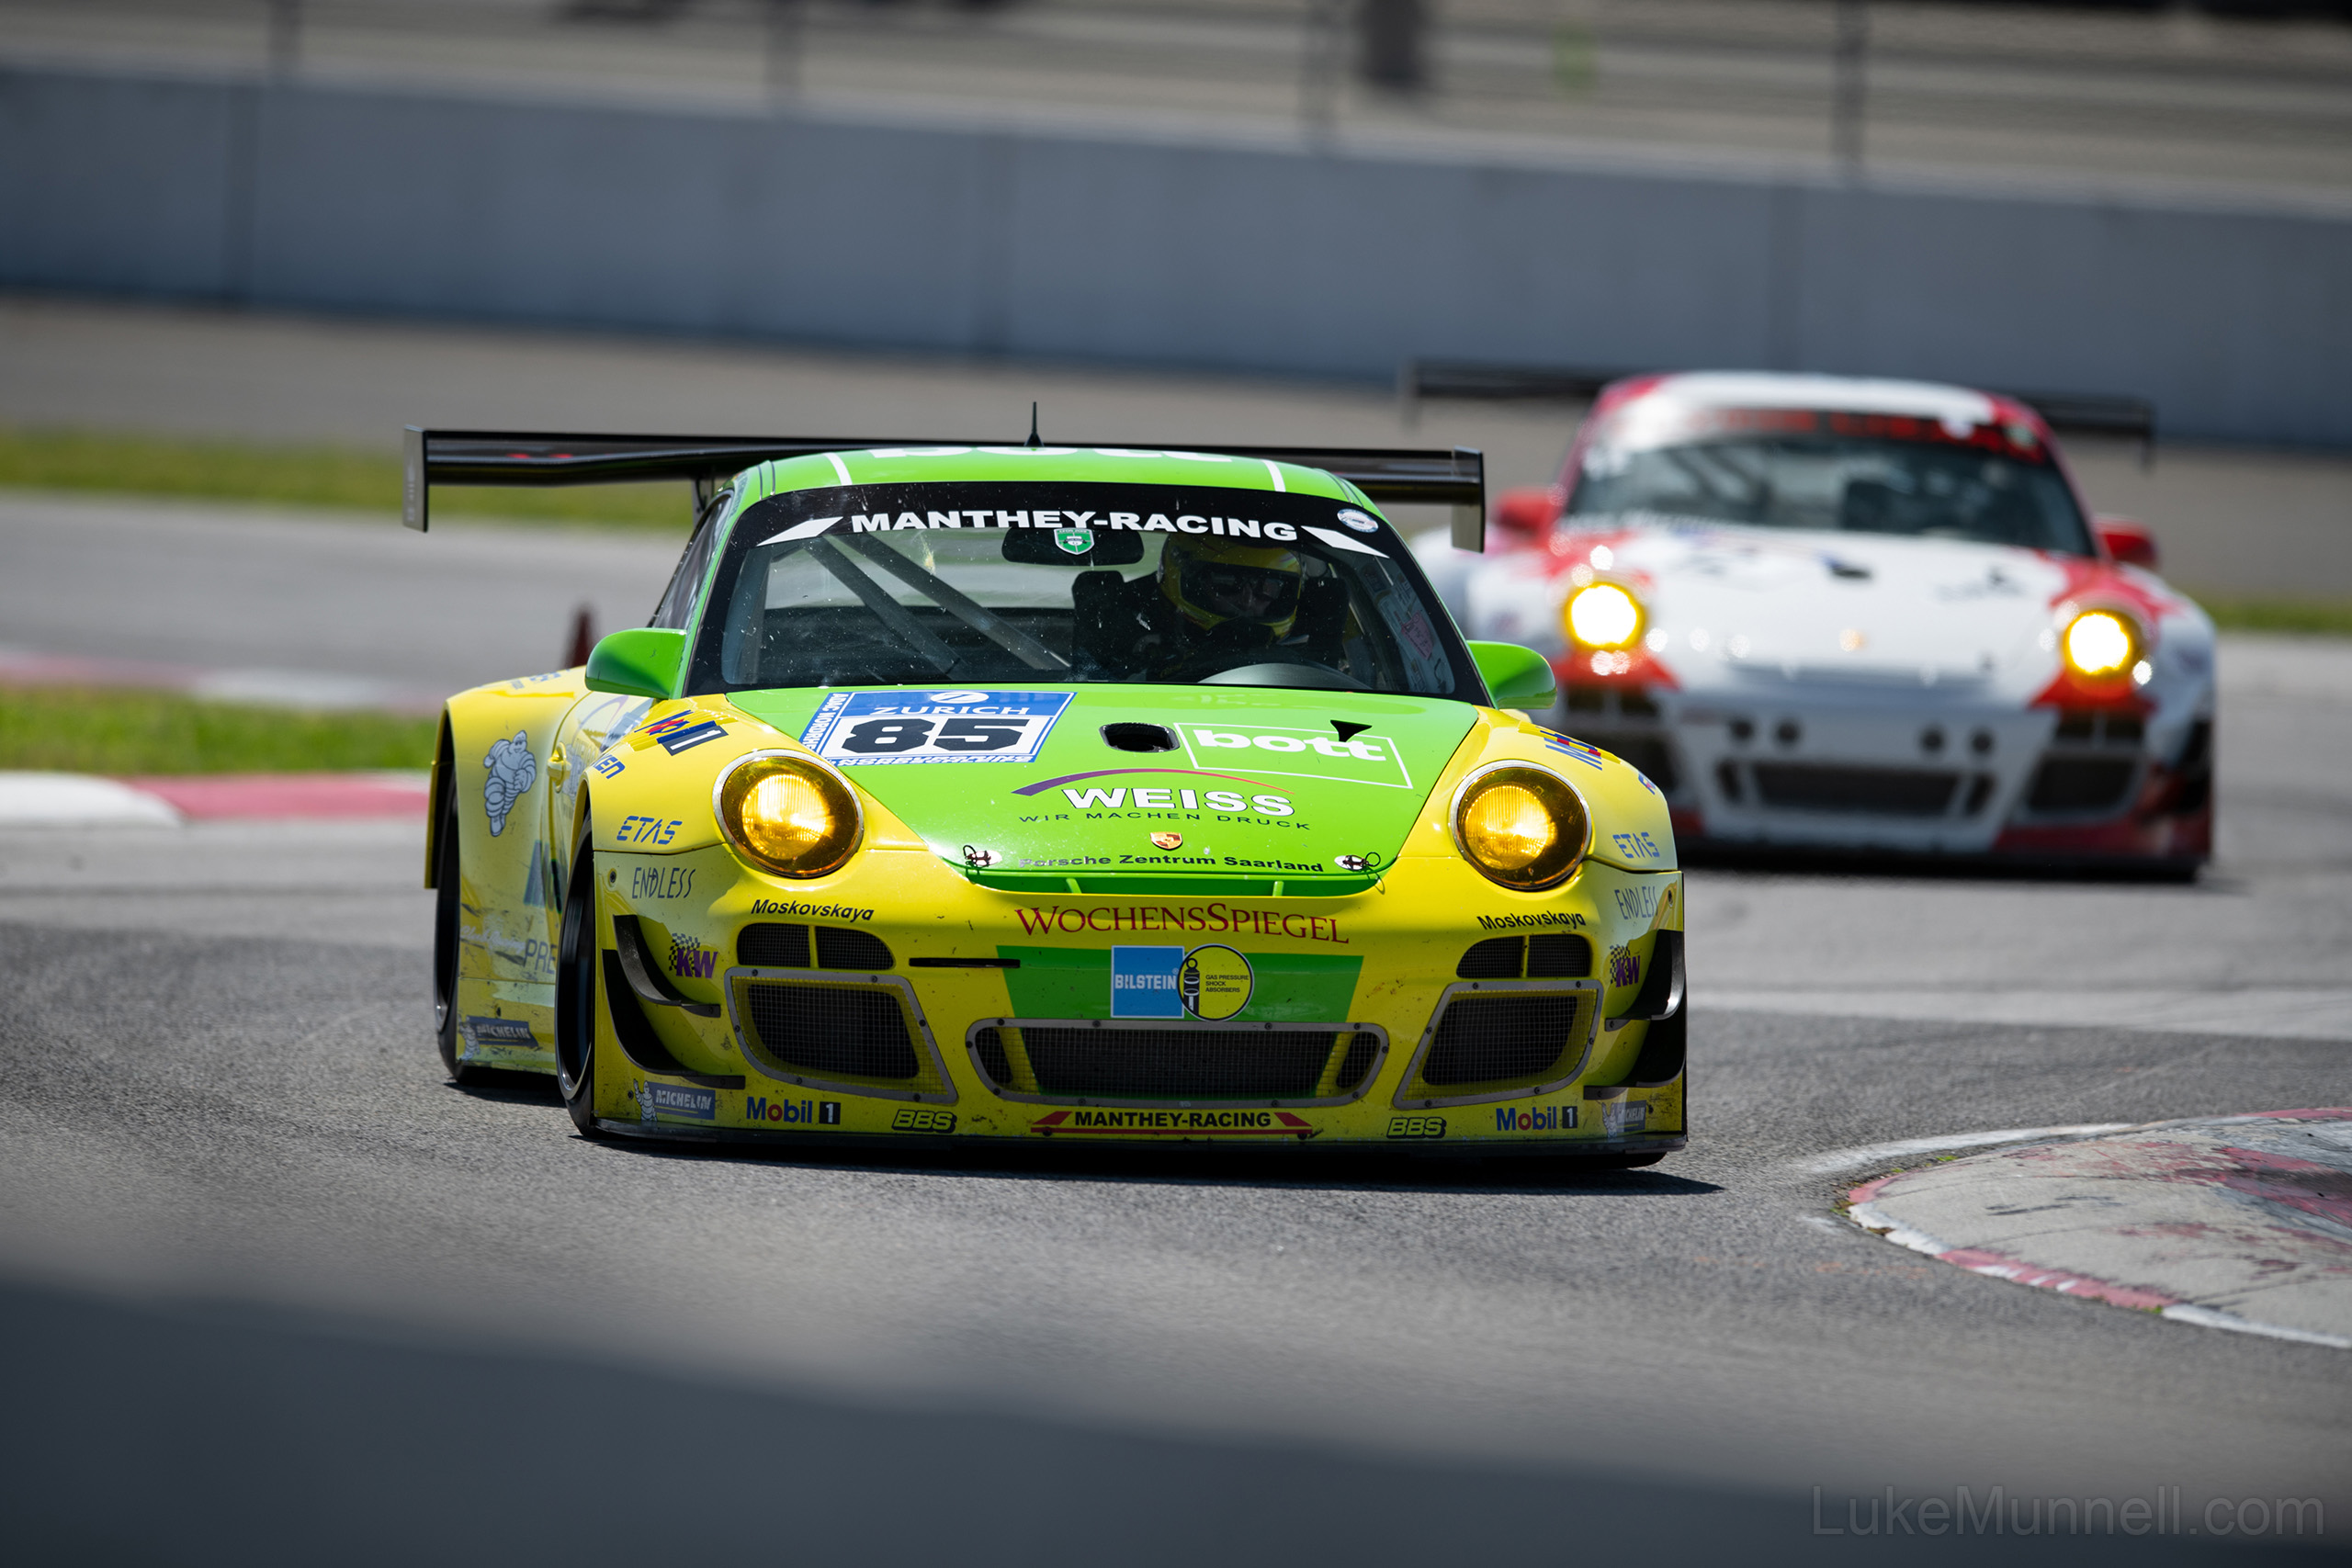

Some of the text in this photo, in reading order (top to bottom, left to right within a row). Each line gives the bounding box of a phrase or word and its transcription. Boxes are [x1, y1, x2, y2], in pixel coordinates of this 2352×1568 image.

[852, 511, 1297, 541] MANTHEY-RACING
[822, 693, 849, 711] ADAC
[869, 706, 1030, 716] ZURICH
[842, 718, 1030, 753] 85
[1193, 729, 1386, 761] bott
[1061, 788, 1295, 817] WEISS
[616, 816, 683, 845] ETAS
[1019, 812, 1310, 830] WIR MACHEN DRUCK
[1612, 832, 1660, 858] ETAS
[1018, 854, 1324, 873] Porsche Zentrum Saarland
[631, 866, 695, 899] ENDLESS
[751, 899, 875, 923] Moskovskaya
[1476, 910, 1586, 930] Moskovskaya
[675, 948, 718, 979] KW
[1616, 955, 1640, 987] KW
[1114, 975, 1176, 990] BILSTEIN
[656, 1089, 712, 1110] MICHELIN
[746, 1097, 813, 1123] Mobil
[891, 1109, 957, 1134] BBS
[1075, 1111, 1271, 1127] MANTHEY-RACING
[1386, 1117, 1446, 1138] BBS
[1496, 1106, 1556, 1131] Mobil
